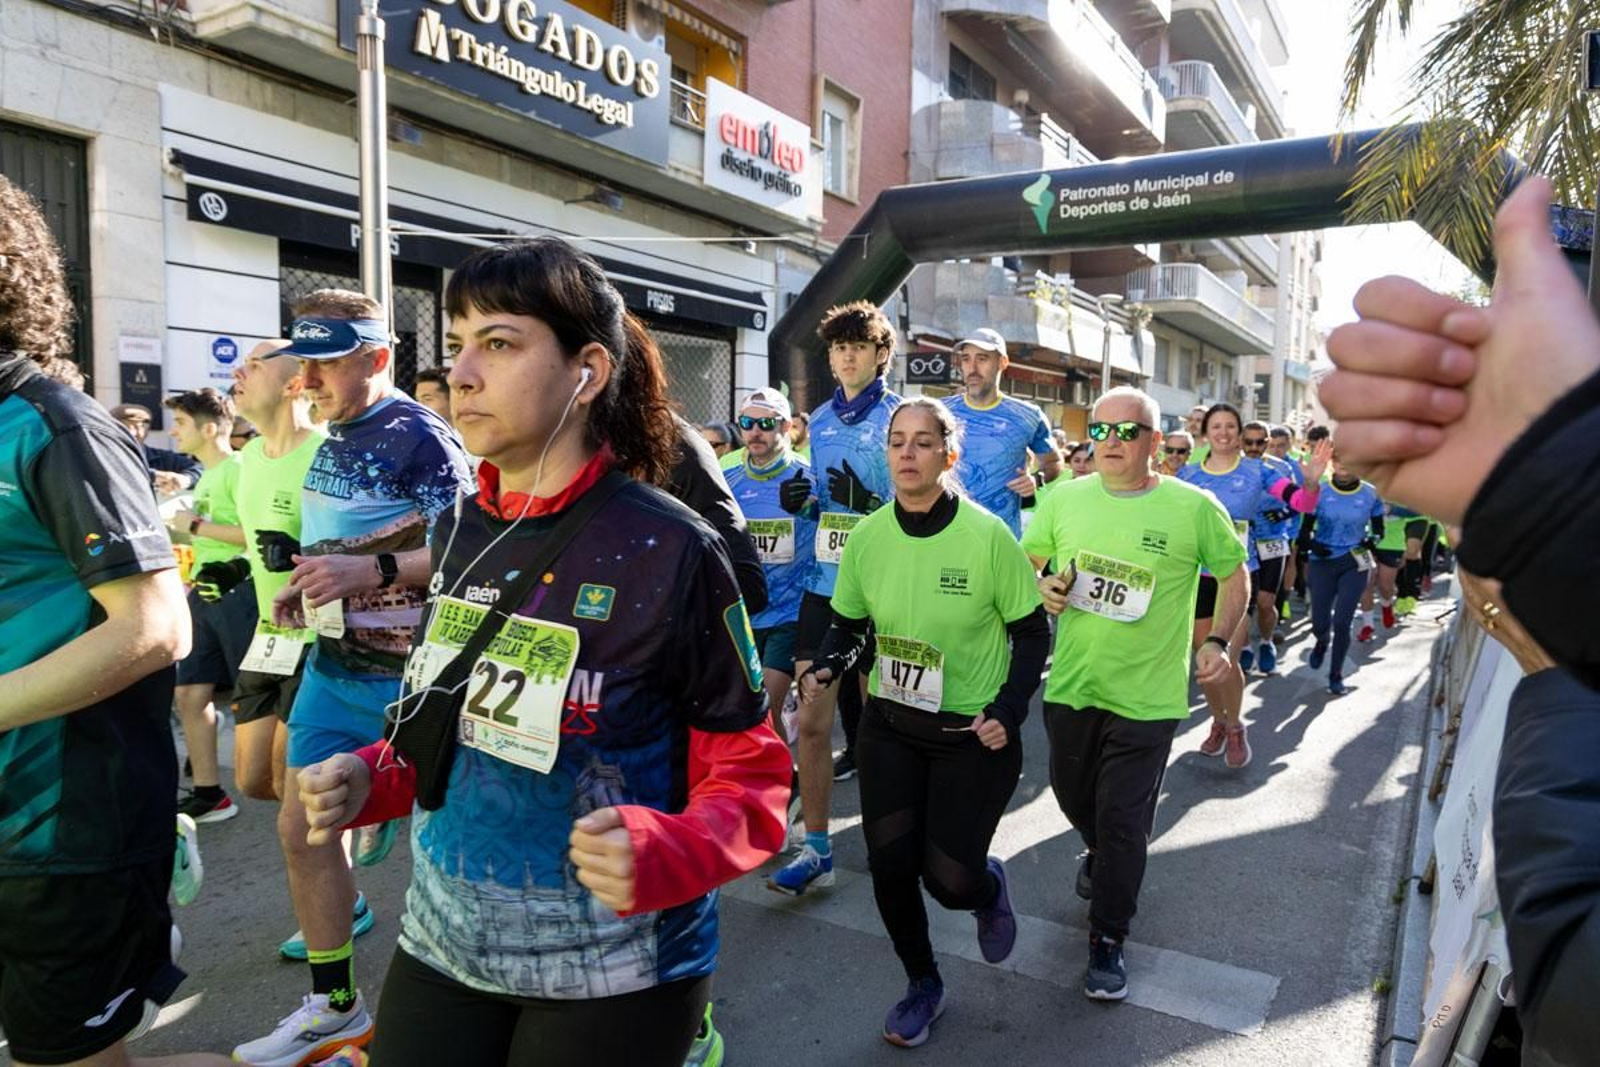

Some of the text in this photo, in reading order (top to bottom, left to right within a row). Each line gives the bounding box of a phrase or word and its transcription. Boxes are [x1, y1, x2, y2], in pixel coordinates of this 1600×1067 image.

[431, 0, 661, 98] OGADOS
[450, 27, 634, 128] Triángulo Legal
[720, 148, 802, 197] diseño gráfico
[1060, 169, 1235, 202] Patronato Municipal de
[1060, 191, 1191, 219] Deportes de Jaén
[1089, 577, 1128, 606] 316
[467, 661, 526, 727] 22
[891, 659, 926, 691] 477
